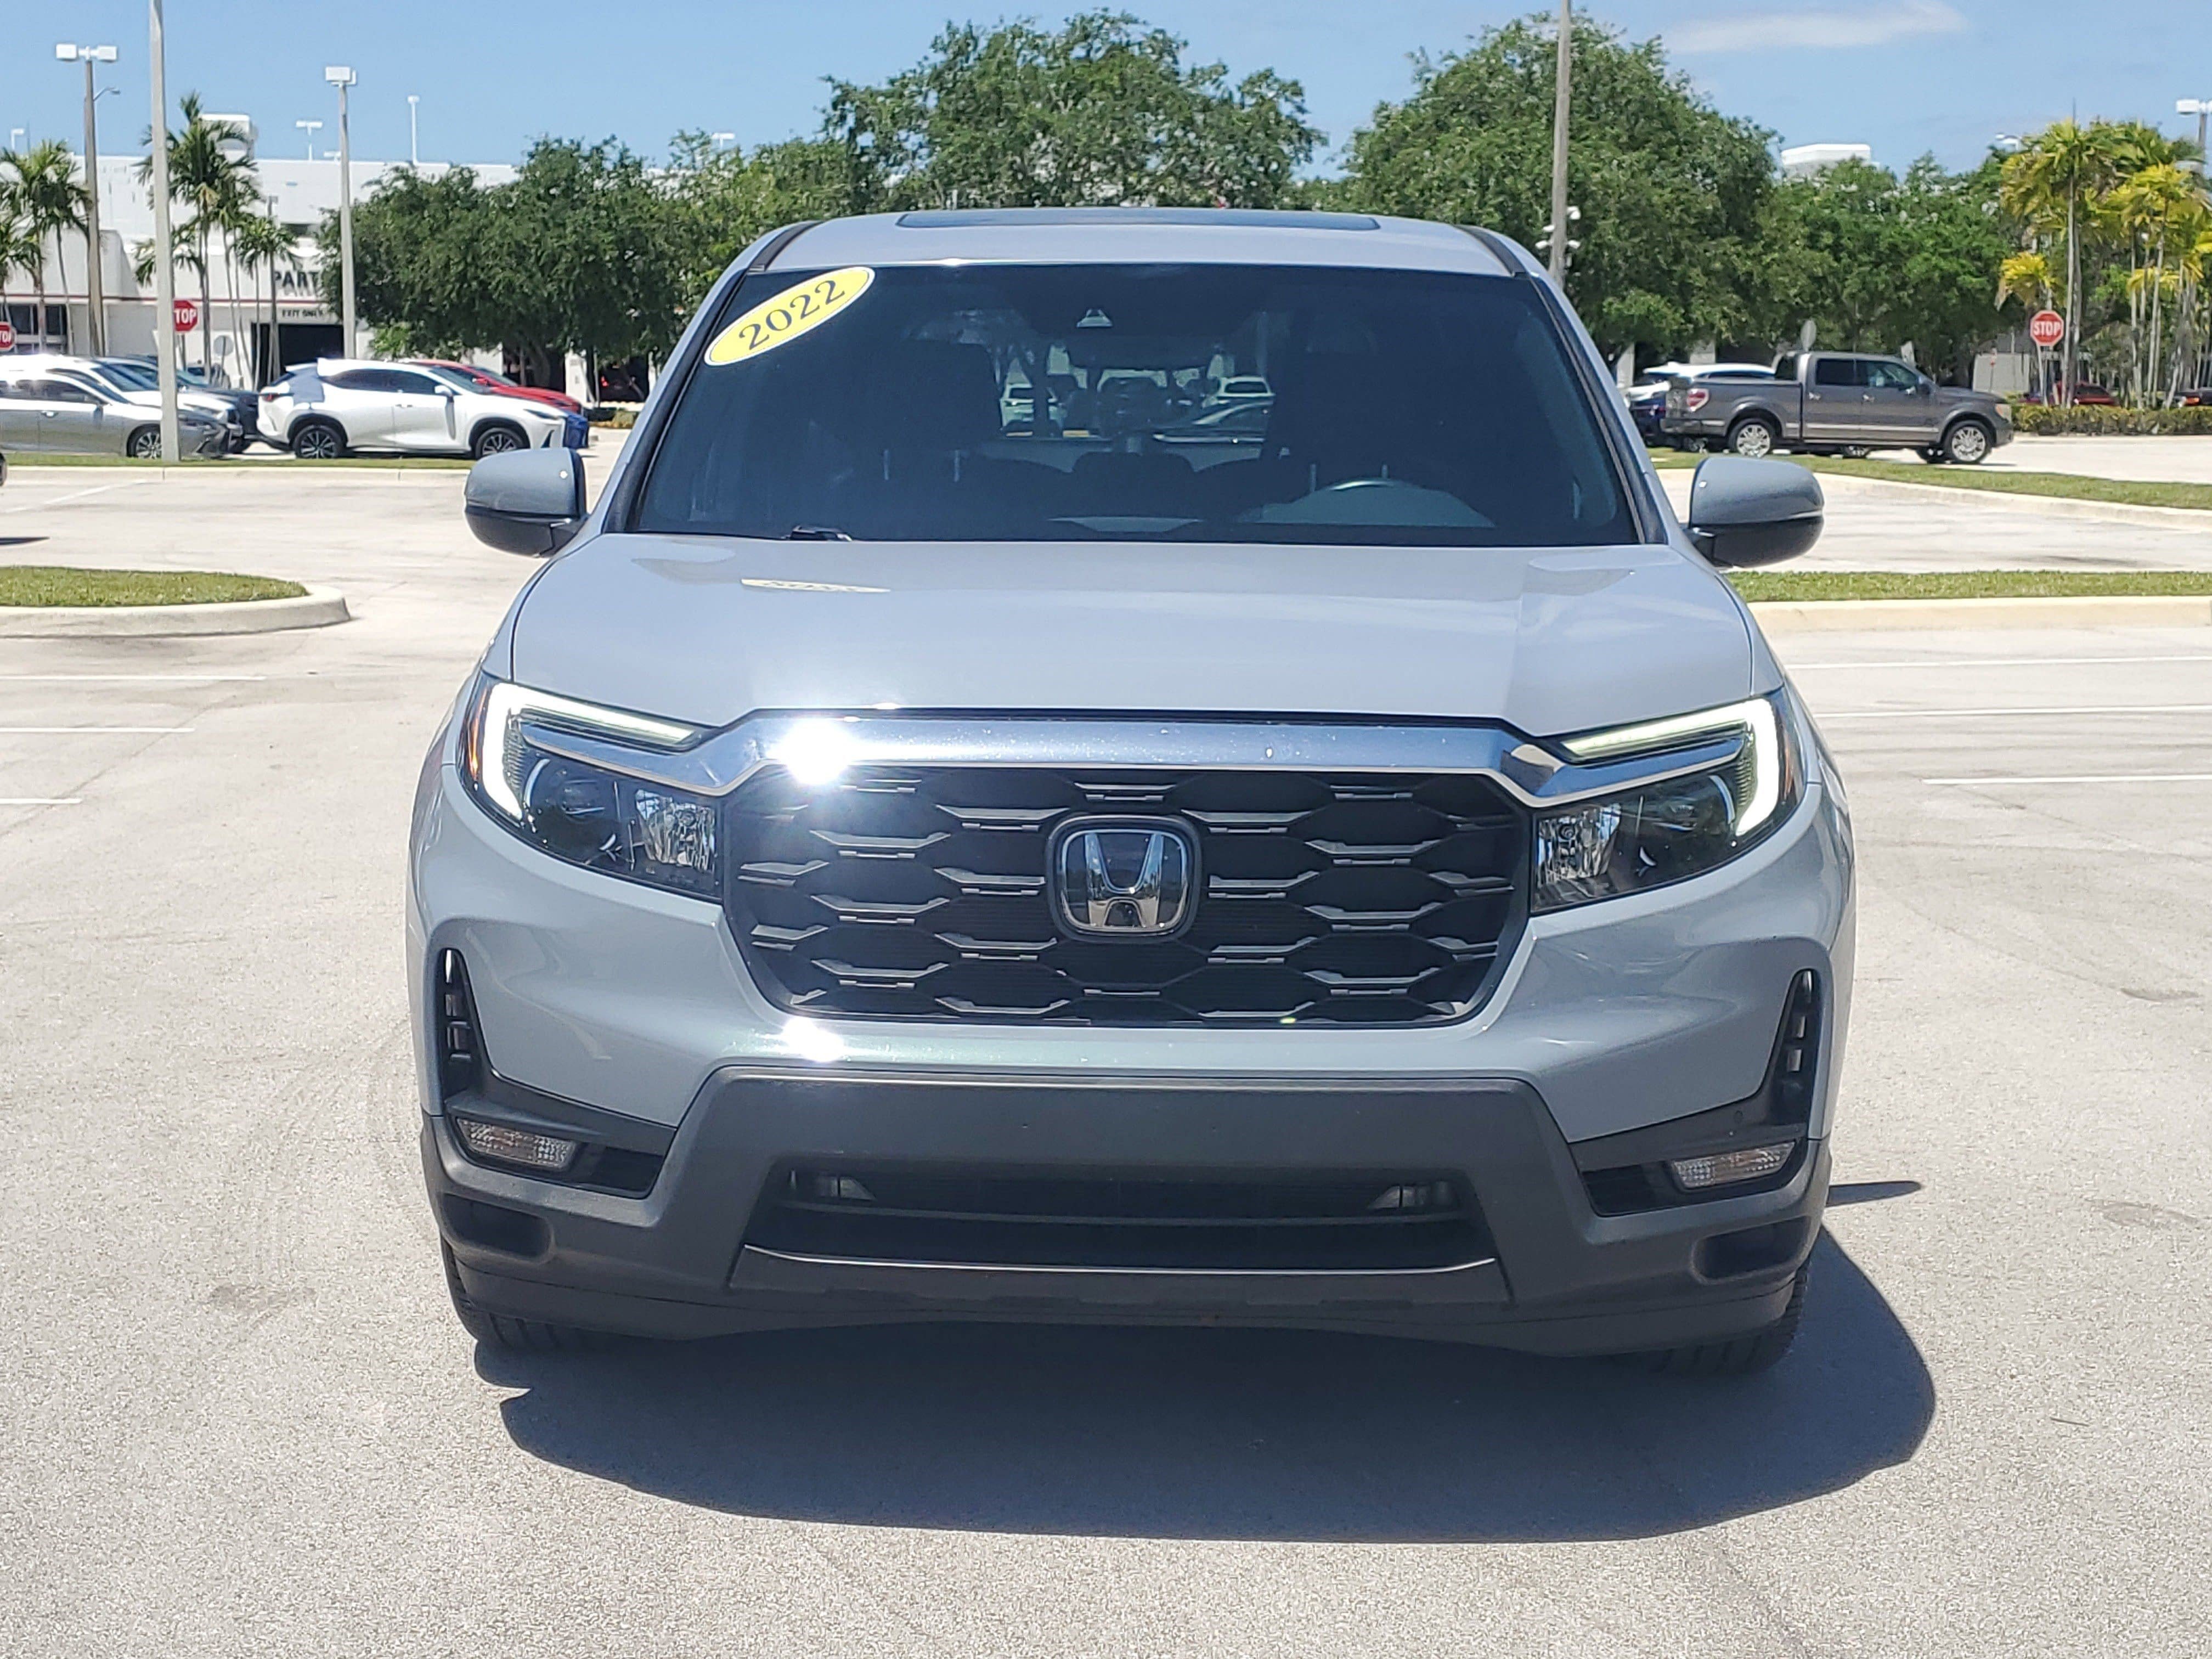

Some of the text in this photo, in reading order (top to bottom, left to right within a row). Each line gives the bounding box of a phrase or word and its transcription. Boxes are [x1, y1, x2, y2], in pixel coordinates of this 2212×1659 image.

[174, 308, 197, 324] TOP
[738, 280, 845, 351] 2022
[2033, 321, 2061, 336] STOP
